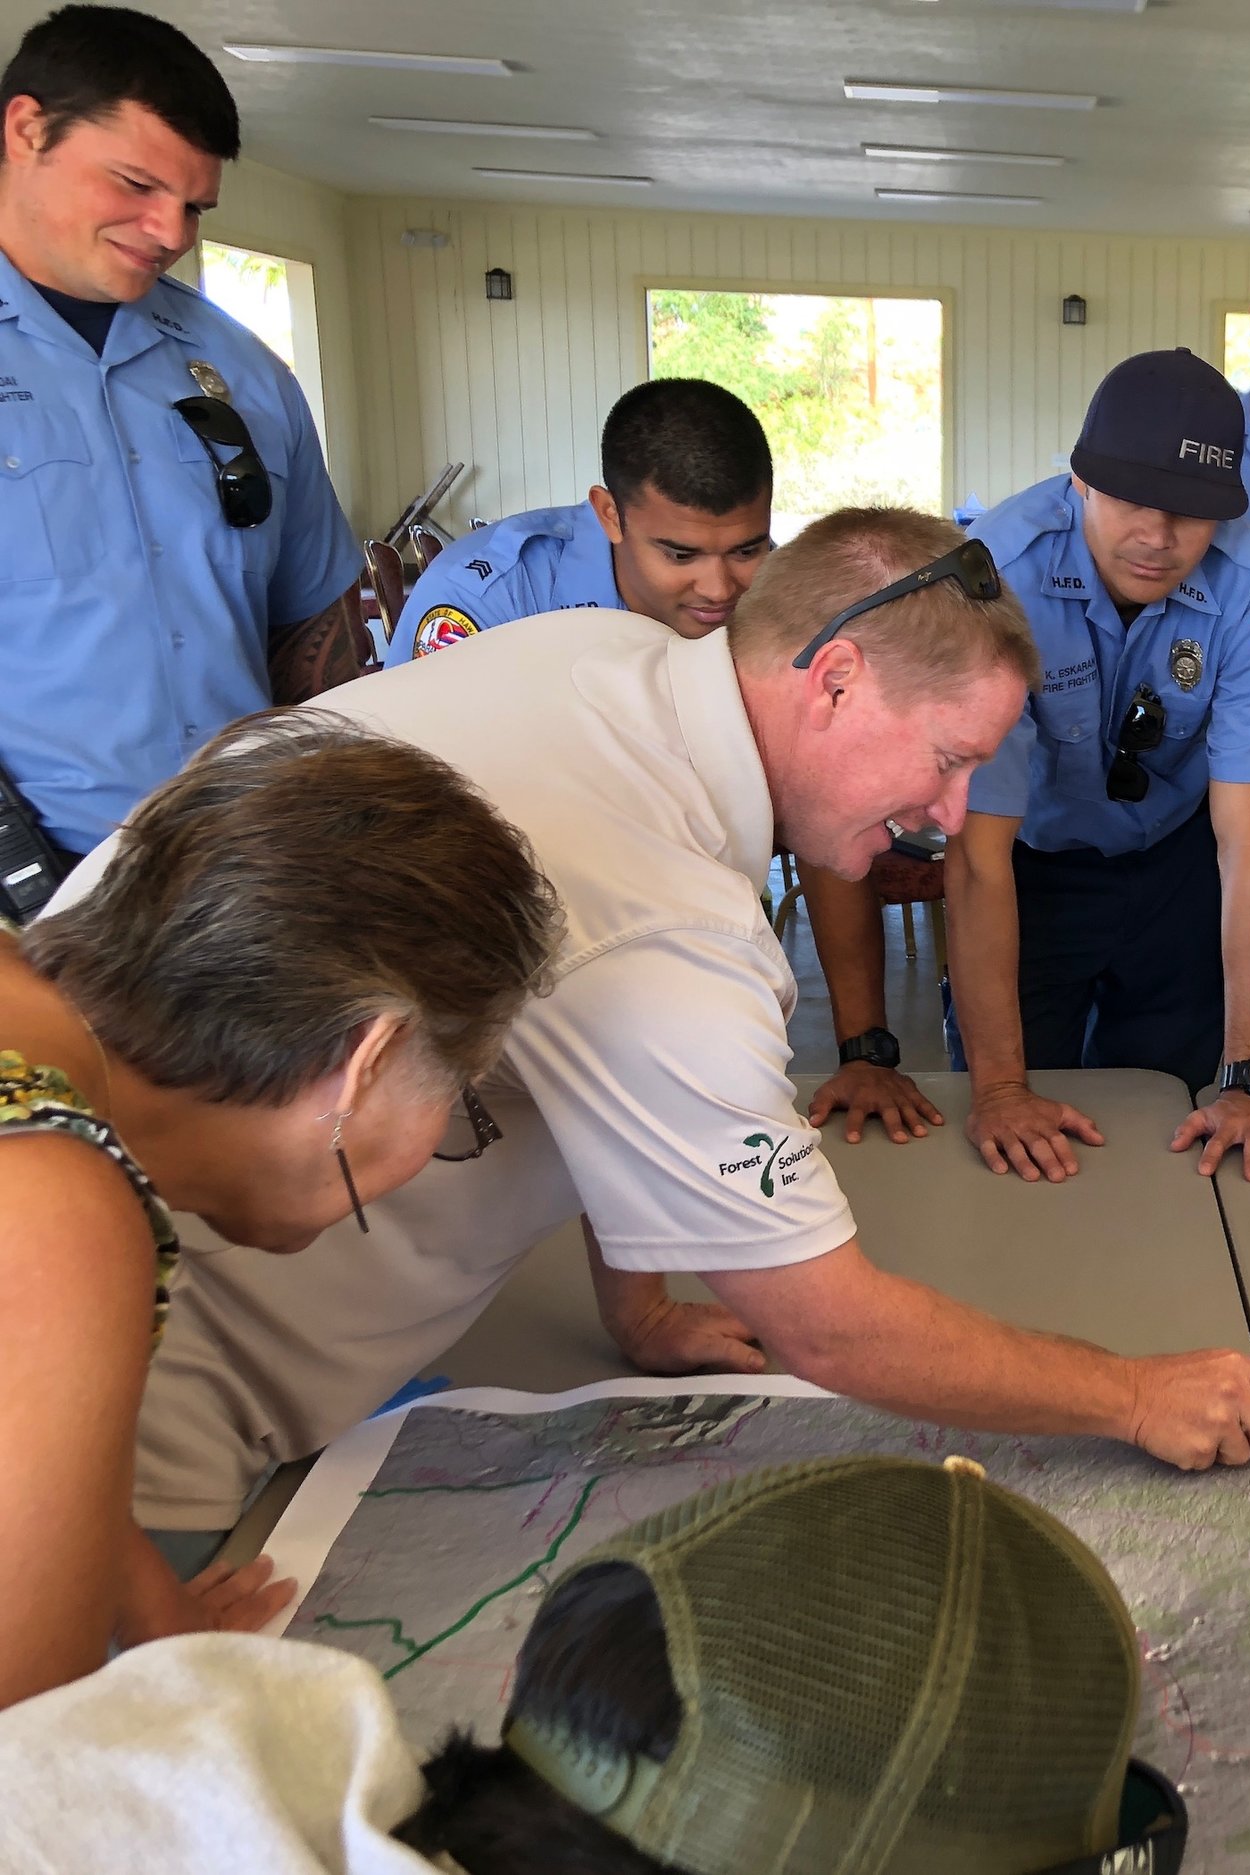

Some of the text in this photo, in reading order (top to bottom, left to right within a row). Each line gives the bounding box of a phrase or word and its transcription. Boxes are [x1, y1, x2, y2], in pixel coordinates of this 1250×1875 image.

[1178, 438, 1235, 470] FIRE
[1052, 576, 1086, 590] H.F.D.
[1179, 582, 1208, 604] H.F.D.
[1045, 670, 1056, 681] K.
[1042, 681, 1065, 694] FIRE
[719, 1154, 763, 1176] Forest
[781, 1171, 800, 1187] Inc.
